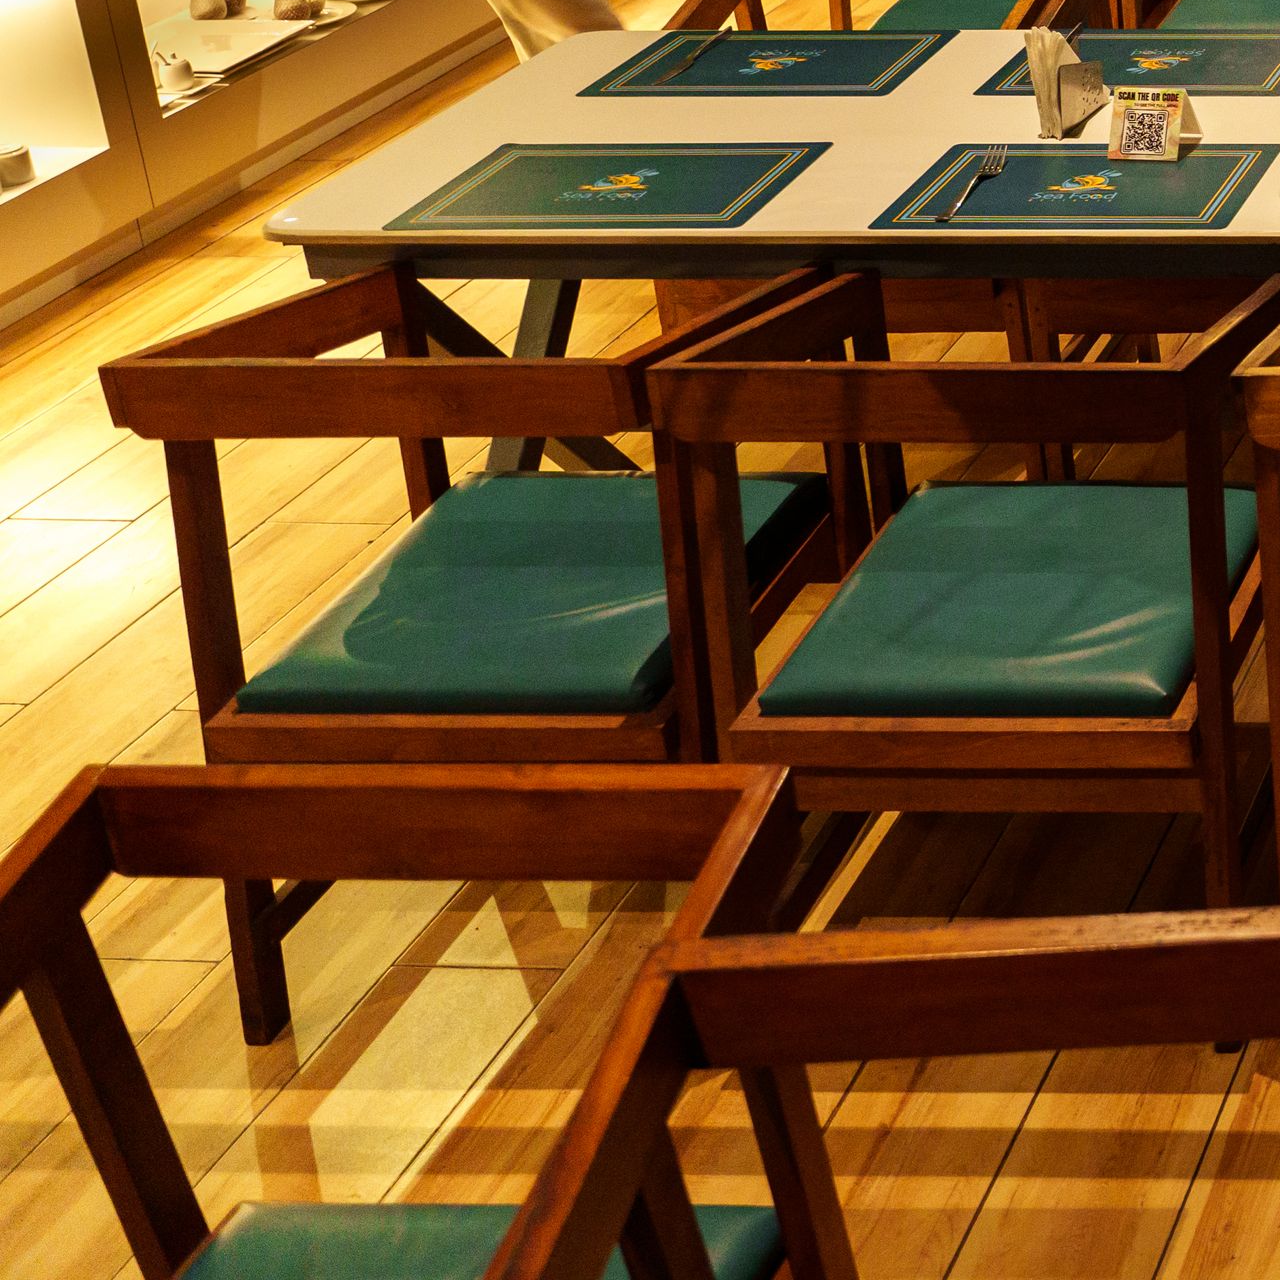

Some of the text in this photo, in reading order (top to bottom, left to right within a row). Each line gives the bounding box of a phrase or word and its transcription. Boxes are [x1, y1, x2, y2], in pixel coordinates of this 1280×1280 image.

[1118, 91, 1180, 102] SCAN THE QR CODE
[559, 191, 647, 199] Sea Food
[1032, 191, 1118, 199] Sea Food
